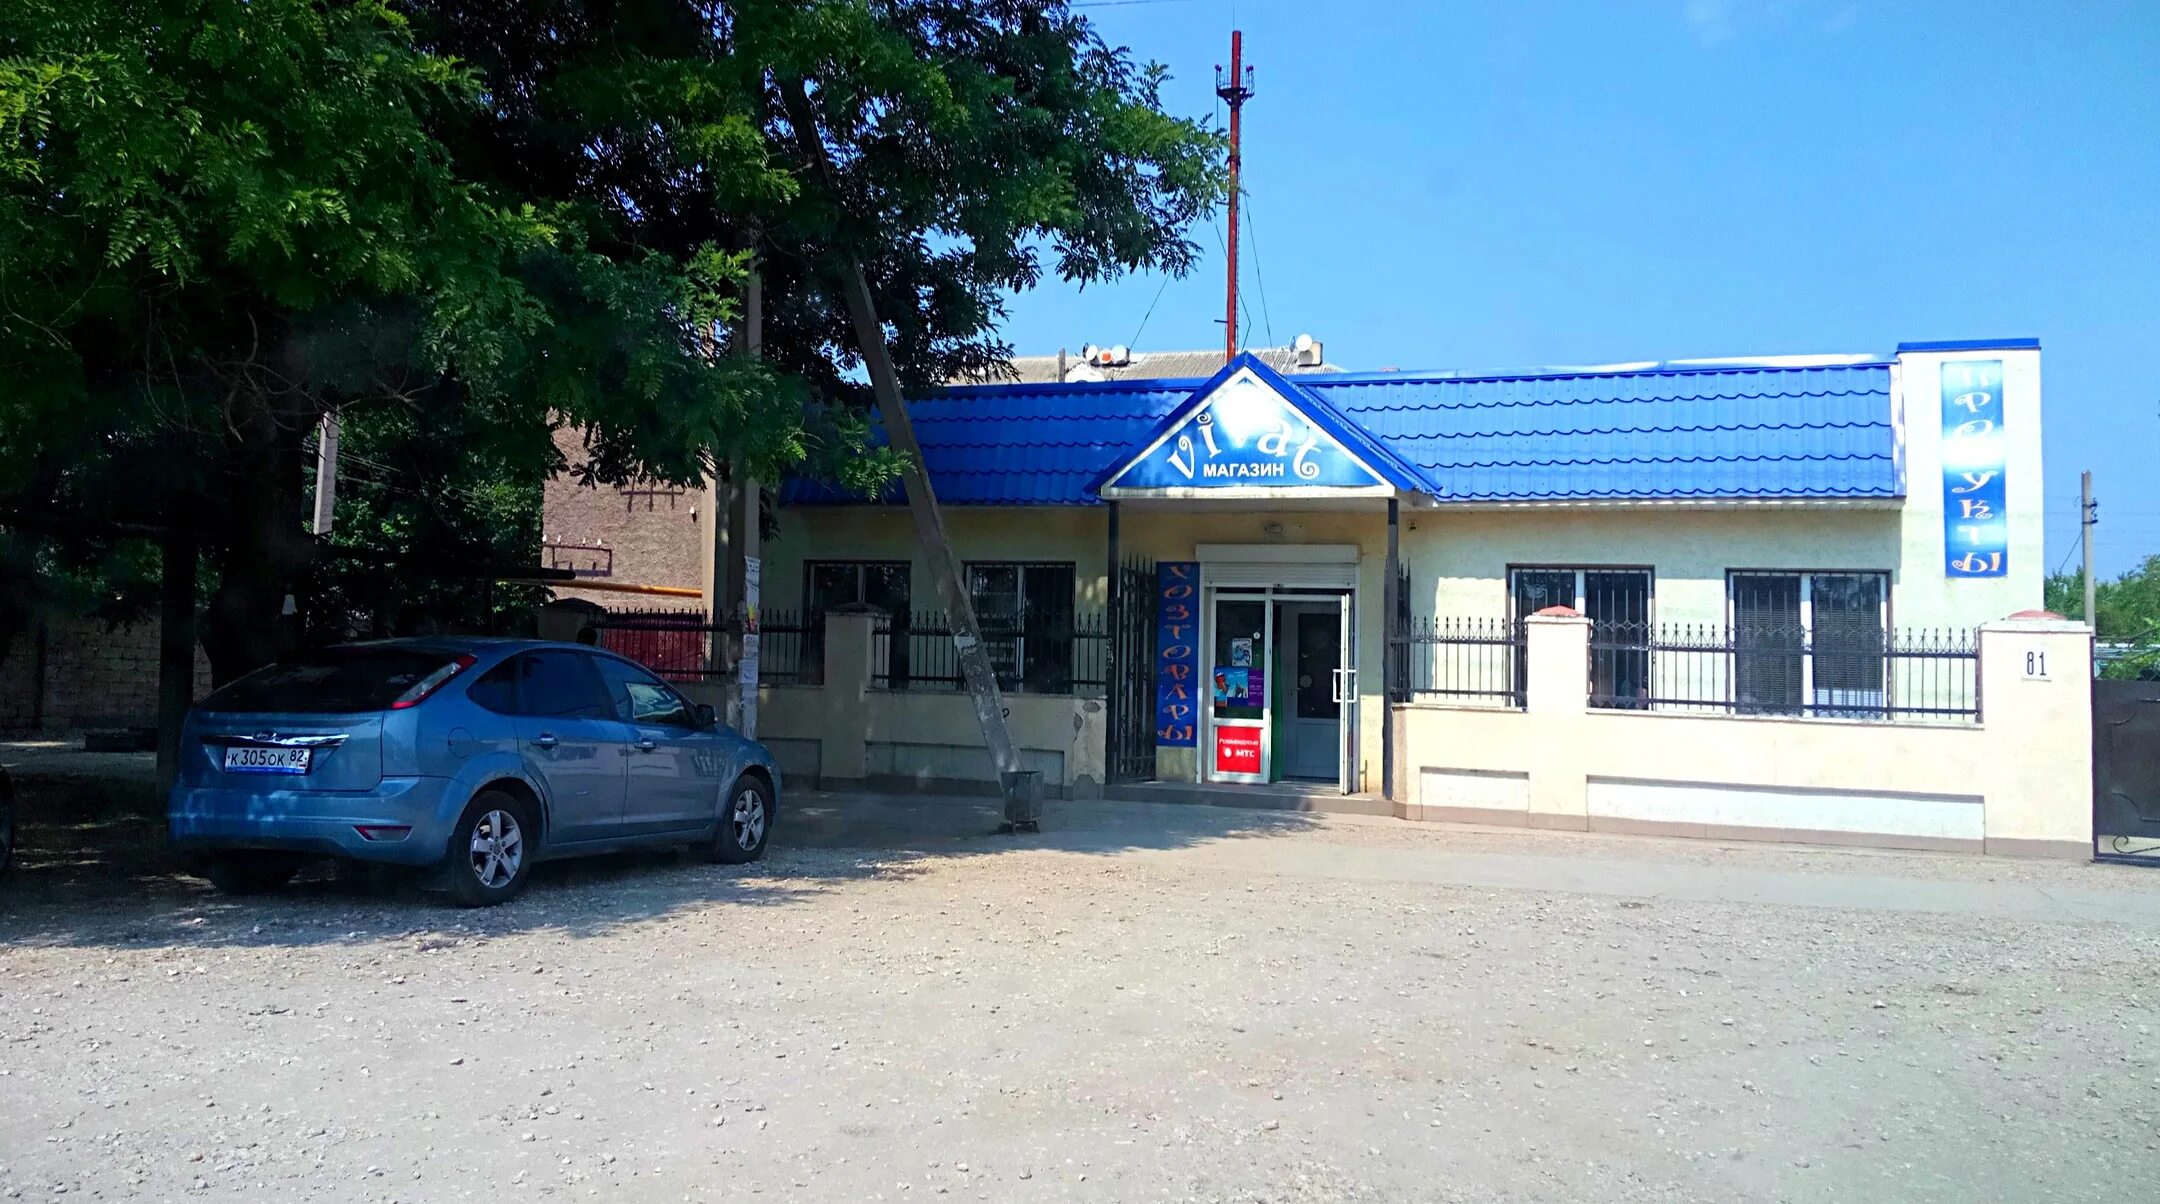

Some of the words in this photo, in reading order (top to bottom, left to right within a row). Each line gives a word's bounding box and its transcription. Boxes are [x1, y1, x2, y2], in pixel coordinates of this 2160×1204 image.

[1203, 463, 1285, 478] МАГАЗИН
[1951, 367, 2001, 573] ПРОУКТЫ
[1157, 564, 1193, 741] ХОЗТОВАРЫ
[2026, 651, 2047, 676] 81
[290, 750, 304, 762] 82
